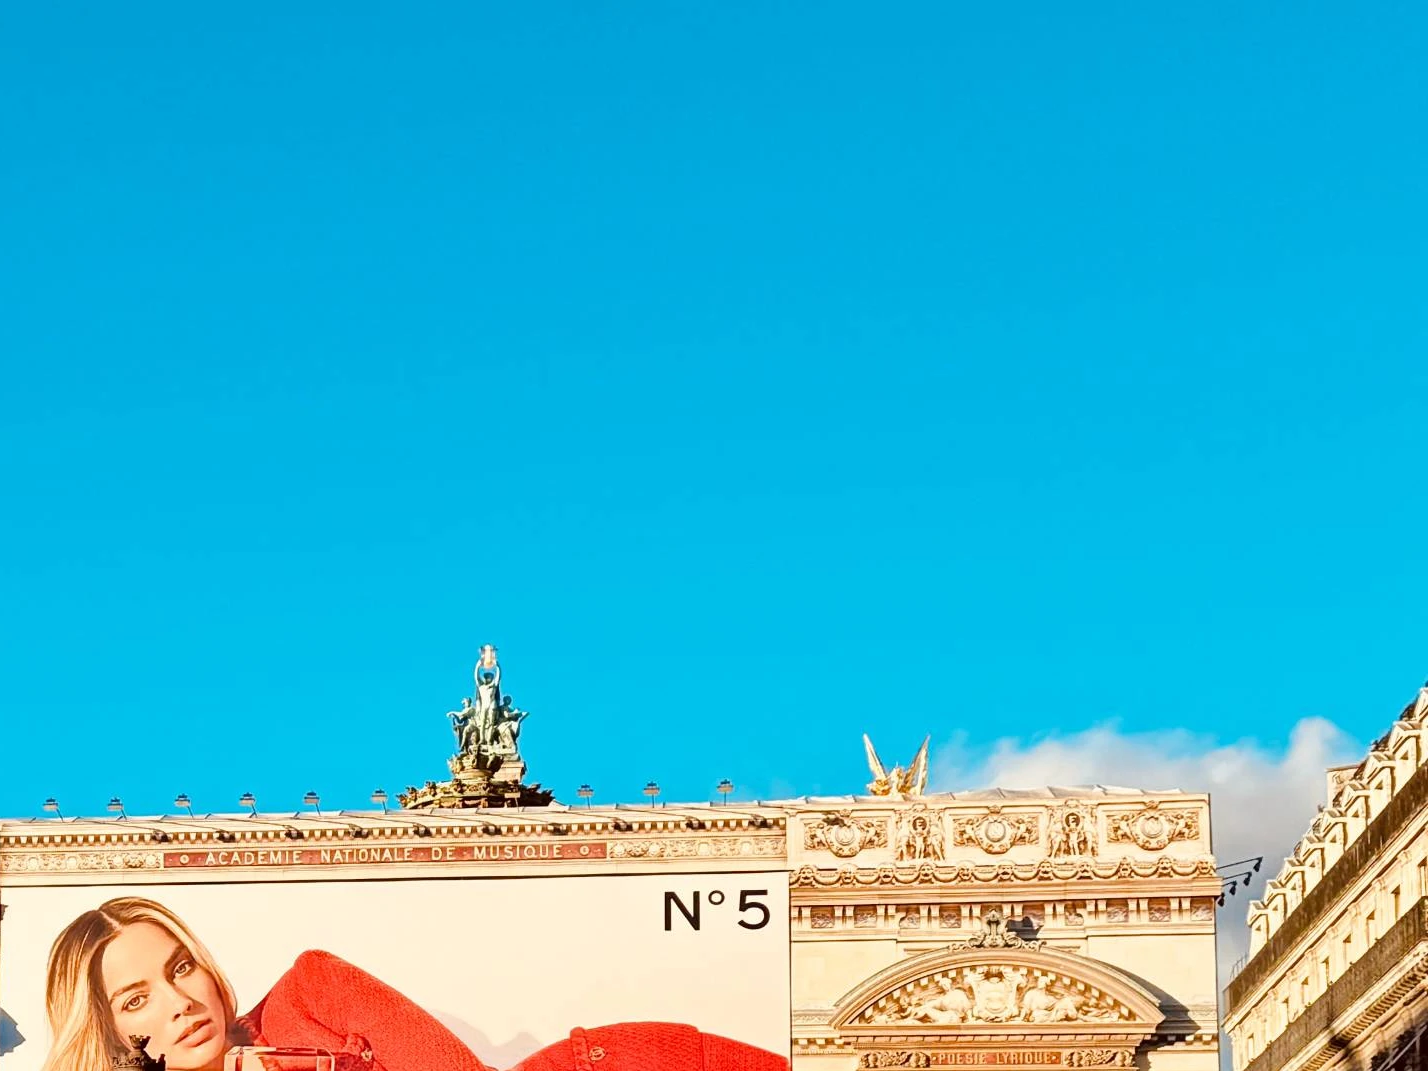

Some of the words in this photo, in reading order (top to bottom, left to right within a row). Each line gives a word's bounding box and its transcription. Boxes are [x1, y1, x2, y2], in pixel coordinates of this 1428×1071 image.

[204, 850, 303, 865] ACADEMIE
[320, 848, 413, 863] NATIONALE
[431, 846, 456, 861] DE
[473, 844, 563, 859] MUSIQUE
[664, 890, 725, 932] N°
[737, 889, 771, 930] 5
[939, 1052, 987, 1065] POESIE
[996, 1051, 1052, 1064] LYRIQUE
